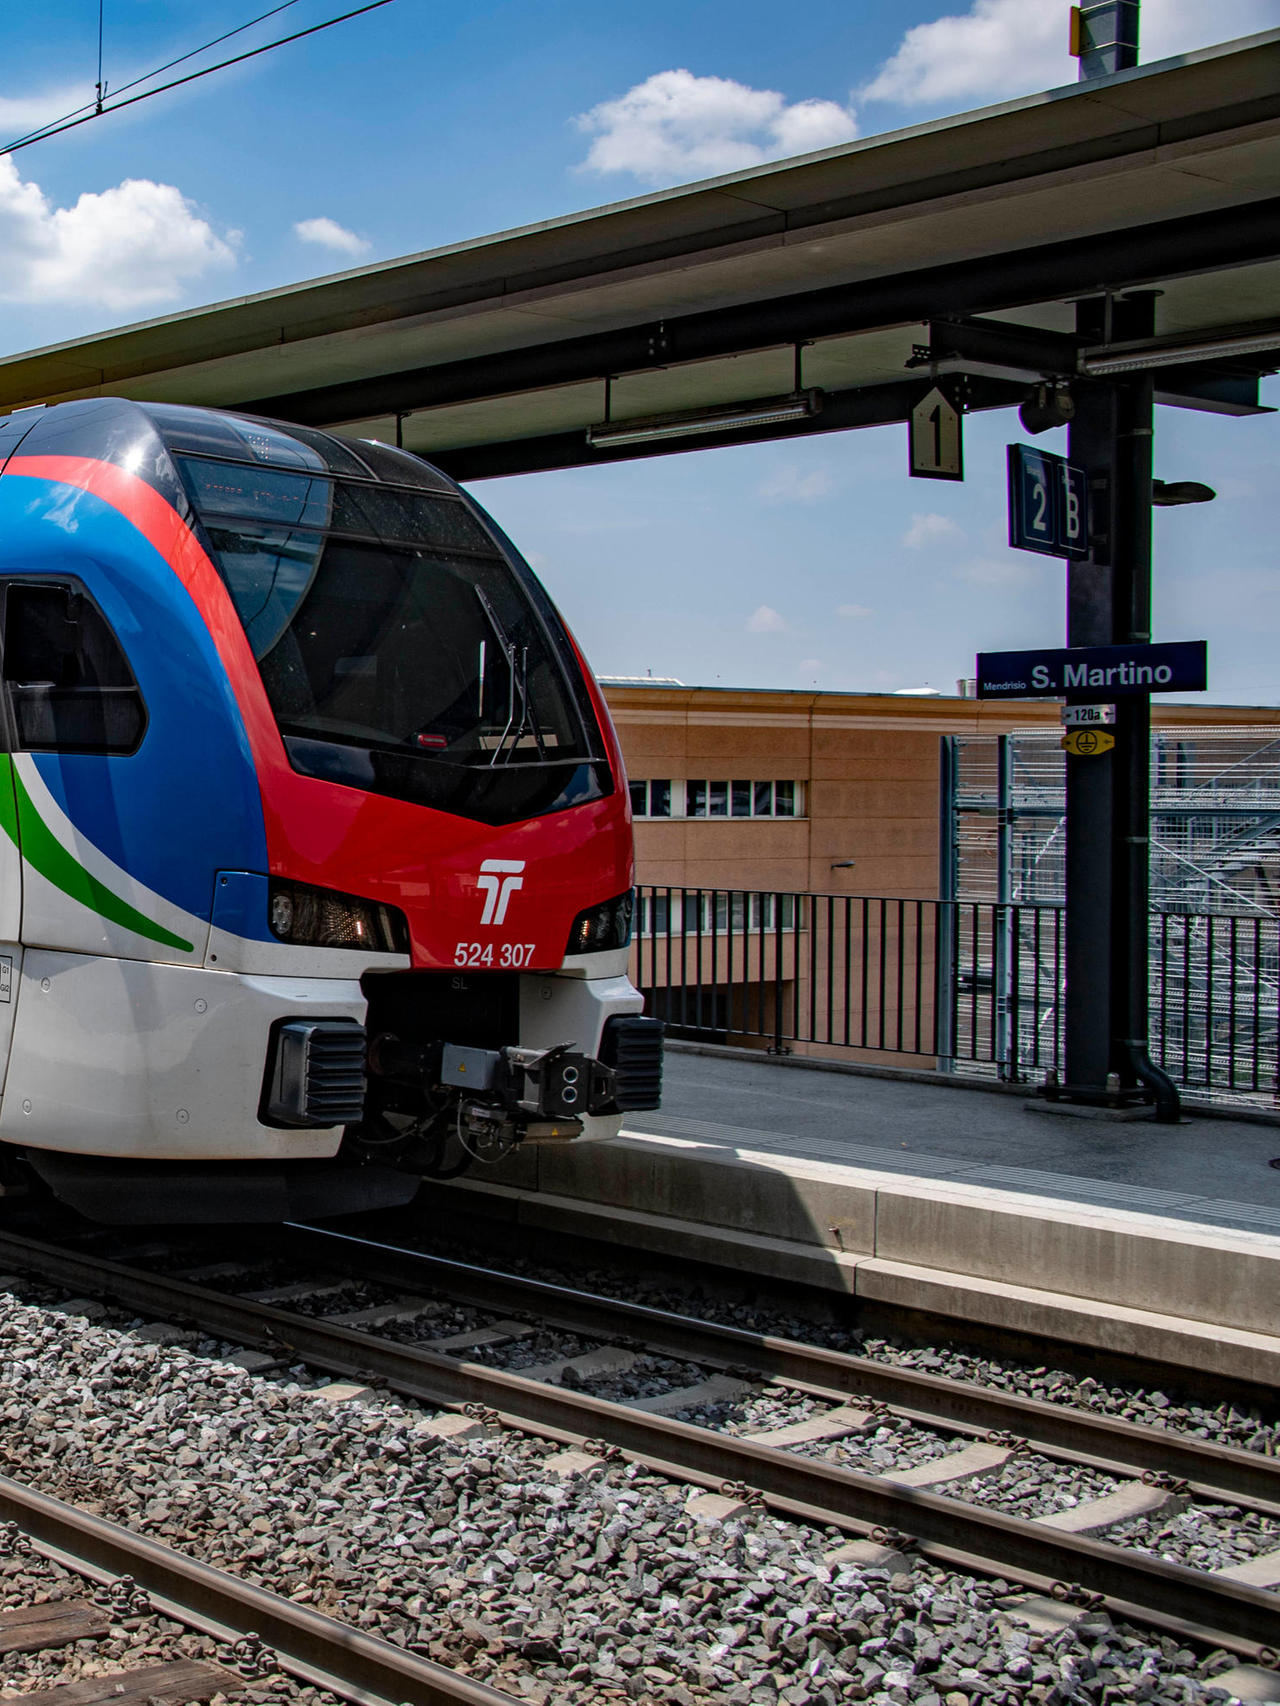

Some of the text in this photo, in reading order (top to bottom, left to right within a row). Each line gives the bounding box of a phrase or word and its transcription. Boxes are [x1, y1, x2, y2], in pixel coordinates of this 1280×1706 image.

[930, 405, 941, 467] 1
[1033, 483, 1080, 539] 2 B
[983, 661, 1172, 691] Mendrisio S. Martino
[1075, 708, 1100, 721] 120a
[454, 943, 536, 967] 524 307
